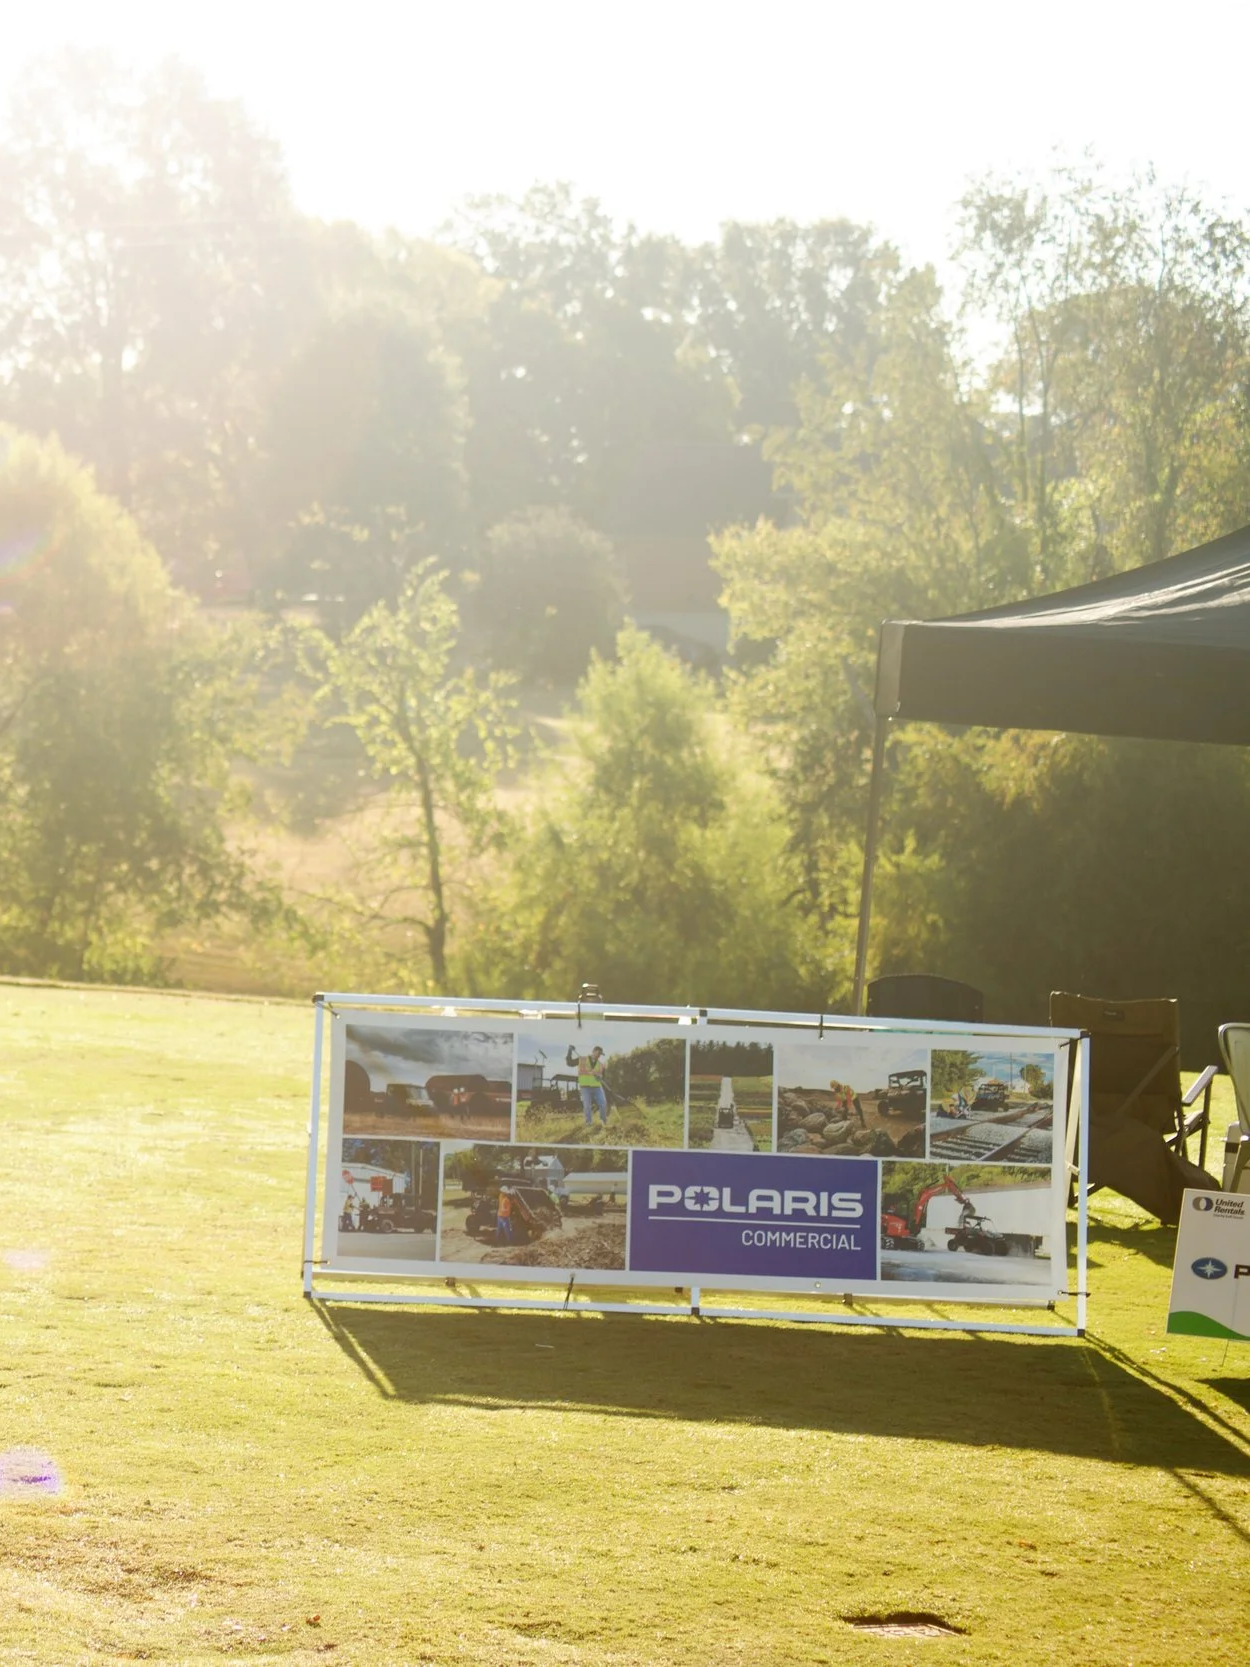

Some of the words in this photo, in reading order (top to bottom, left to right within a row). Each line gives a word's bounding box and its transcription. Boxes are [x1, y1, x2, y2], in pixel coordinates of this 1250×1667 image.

[648, 1184, 863, 1218] POLARIS
[1216, 1198, 1244, 1208] United
[1214, 1206, 1245, 1215] Rentals
[742, 1230, 861, 1250] COMMERCIAL
